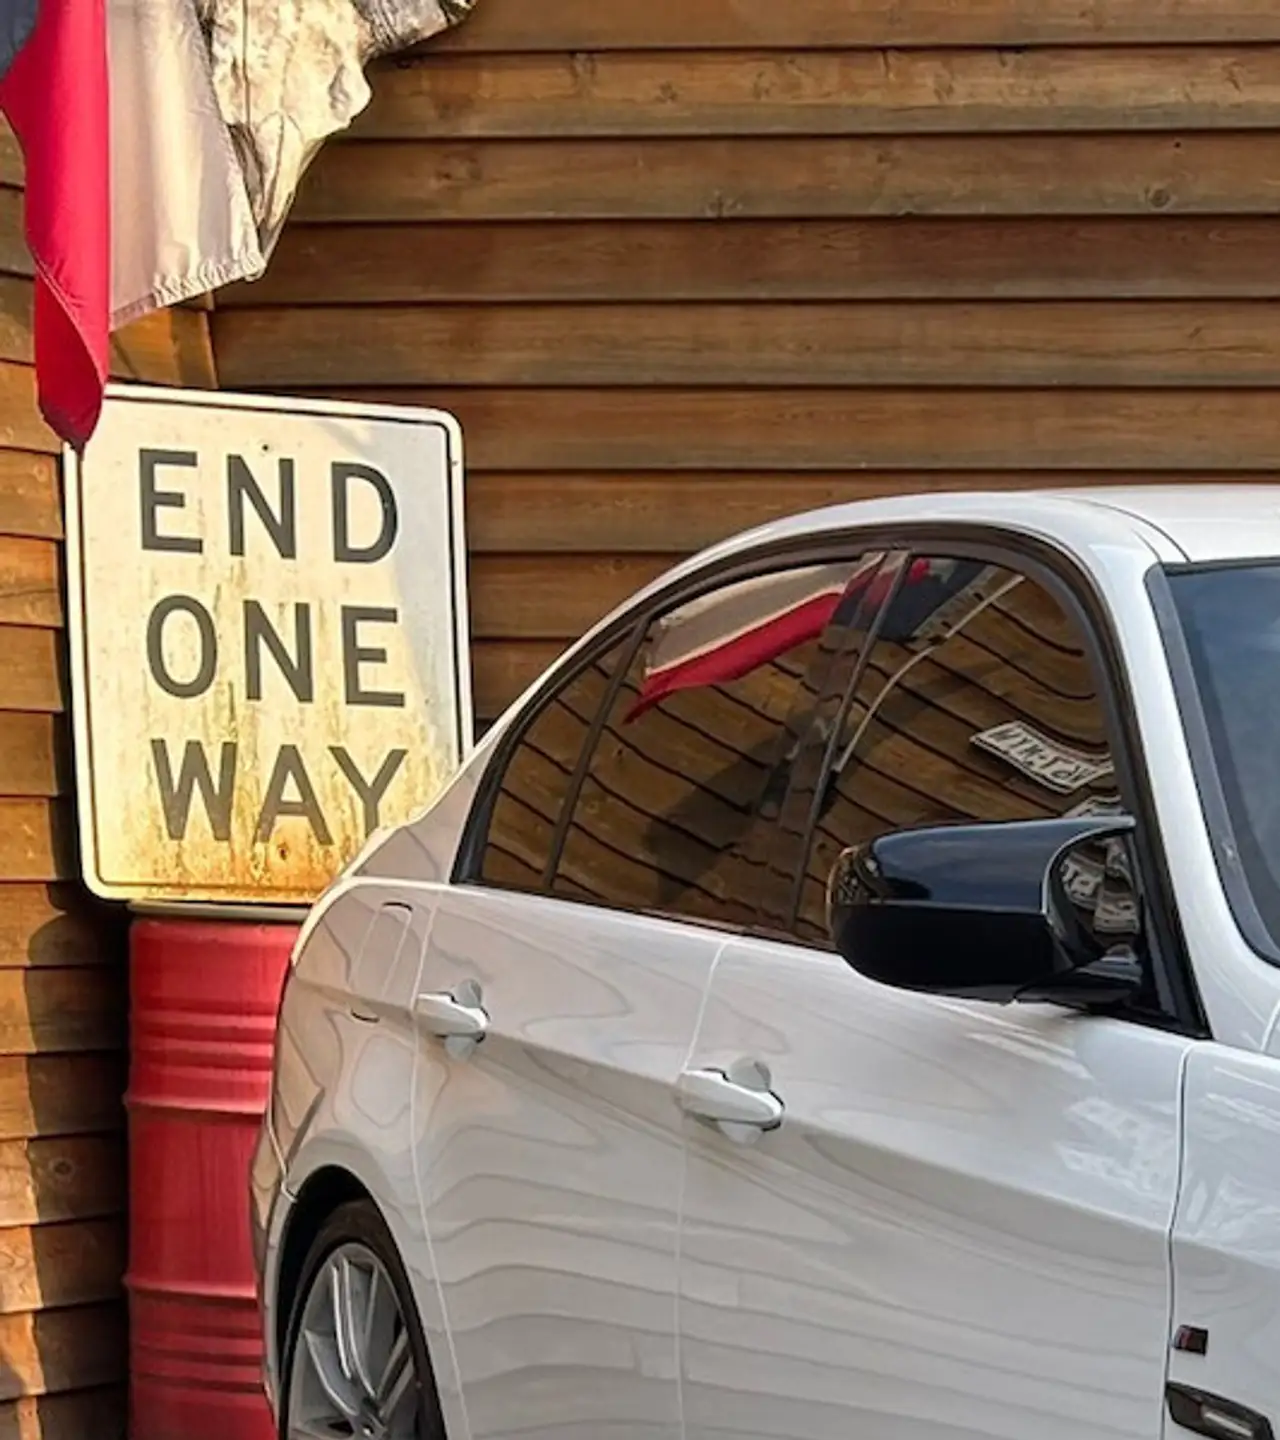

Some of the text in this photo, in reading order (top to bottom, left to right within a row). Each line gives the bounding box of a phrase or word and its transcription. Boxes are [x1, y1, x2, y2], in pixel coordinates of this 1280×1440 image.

[138, 447, 400, 564] END
[146, 594, 406, 708] ONE
[150, 738, 410, 847] WAY
